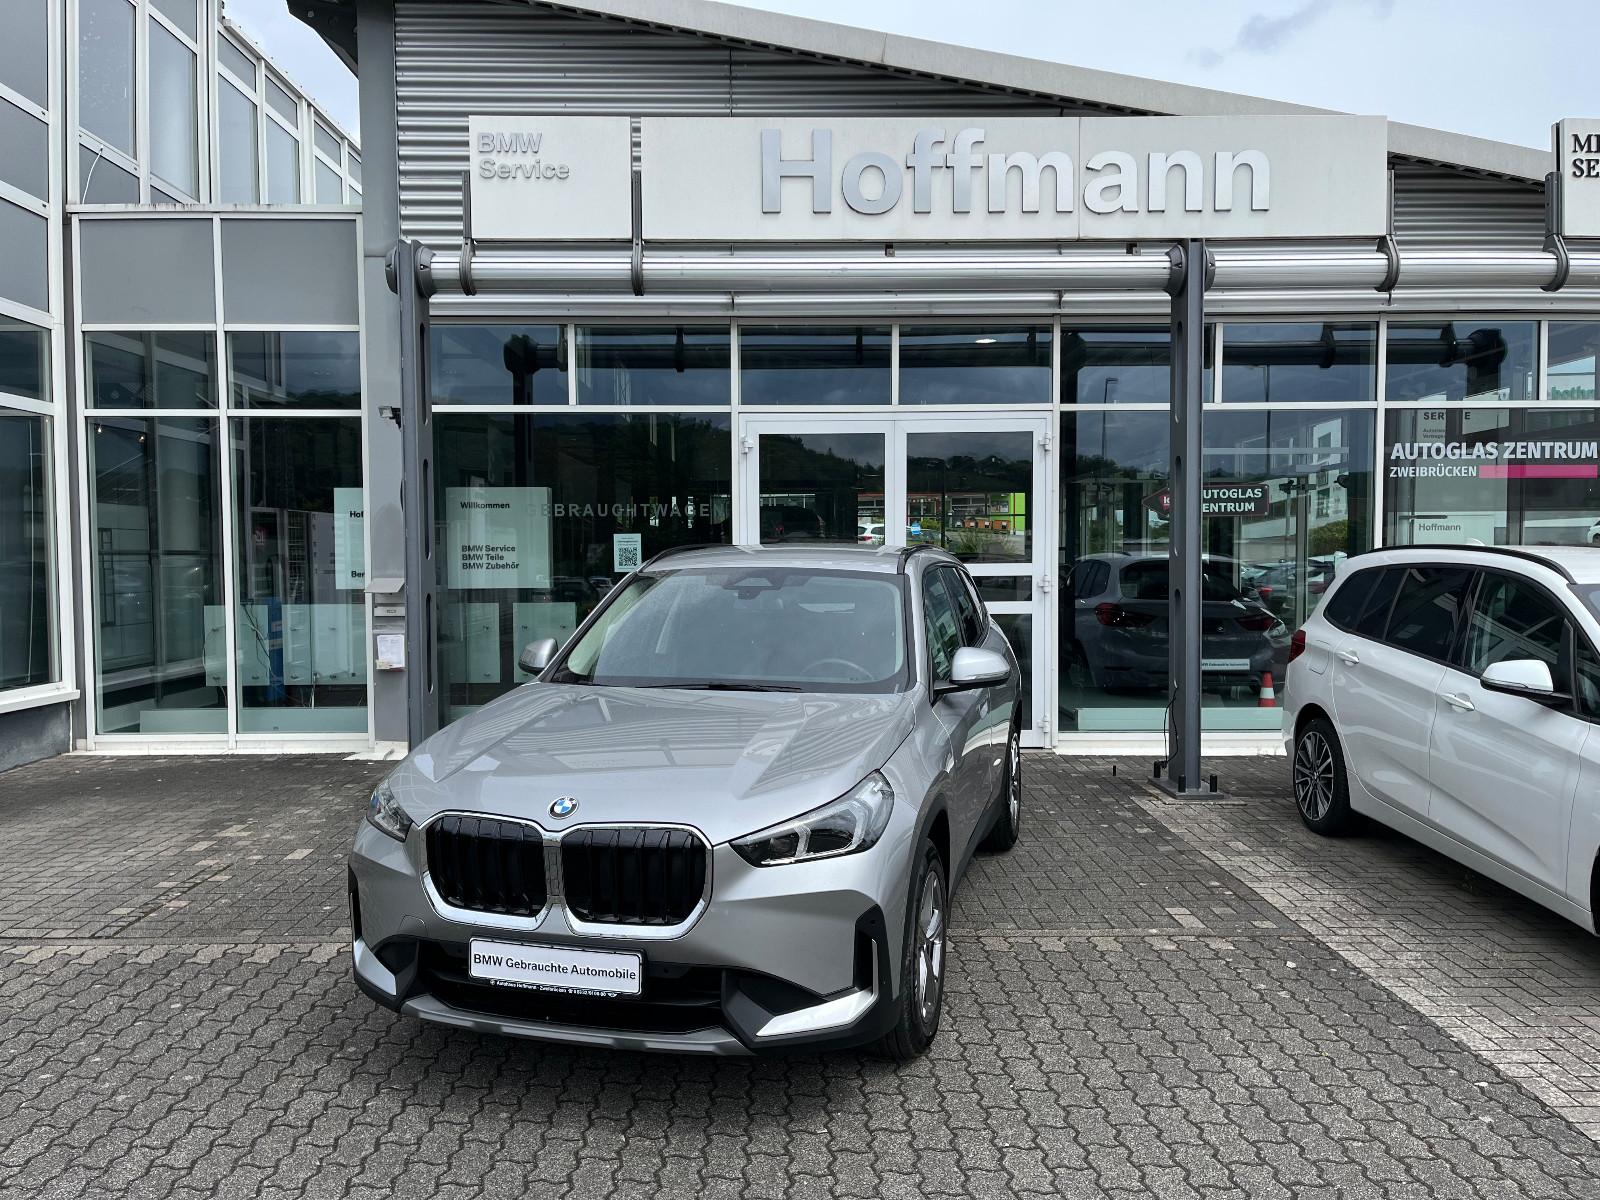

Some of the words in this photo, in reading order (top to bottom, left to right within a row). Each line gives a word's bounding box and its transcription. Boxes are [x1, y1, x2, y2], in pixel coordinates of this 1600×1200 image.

[478, 132, 542, 153] BMW
[479, 158, 570, 180] Service
[761, 127, 1270, 216] Hoffmann
[1390, 441, 1499, 460] AUTOGLAS
[1503, 441, 1598, 459] ZENTRUM
[1389, 463, 1477, 478] ZWEIBRÜCKEN
[1202, 488, 1262, 499] UTOGLAS
[460, 501, 511, 509] Willkommen
[1202, 502, 1255, 513] ENTRUM
[1418, 523, 1461, 531] Hoffmann
[486, 553, 505, 561] Teile
[462, 562, 484, 570] BMW
[485, 561, 520, 570] Zubehör
[473, 953, 503, 966] BMW
[505, 958, 568, 973] Gebrauchte
[571, 964, 636, 980] Automobile
